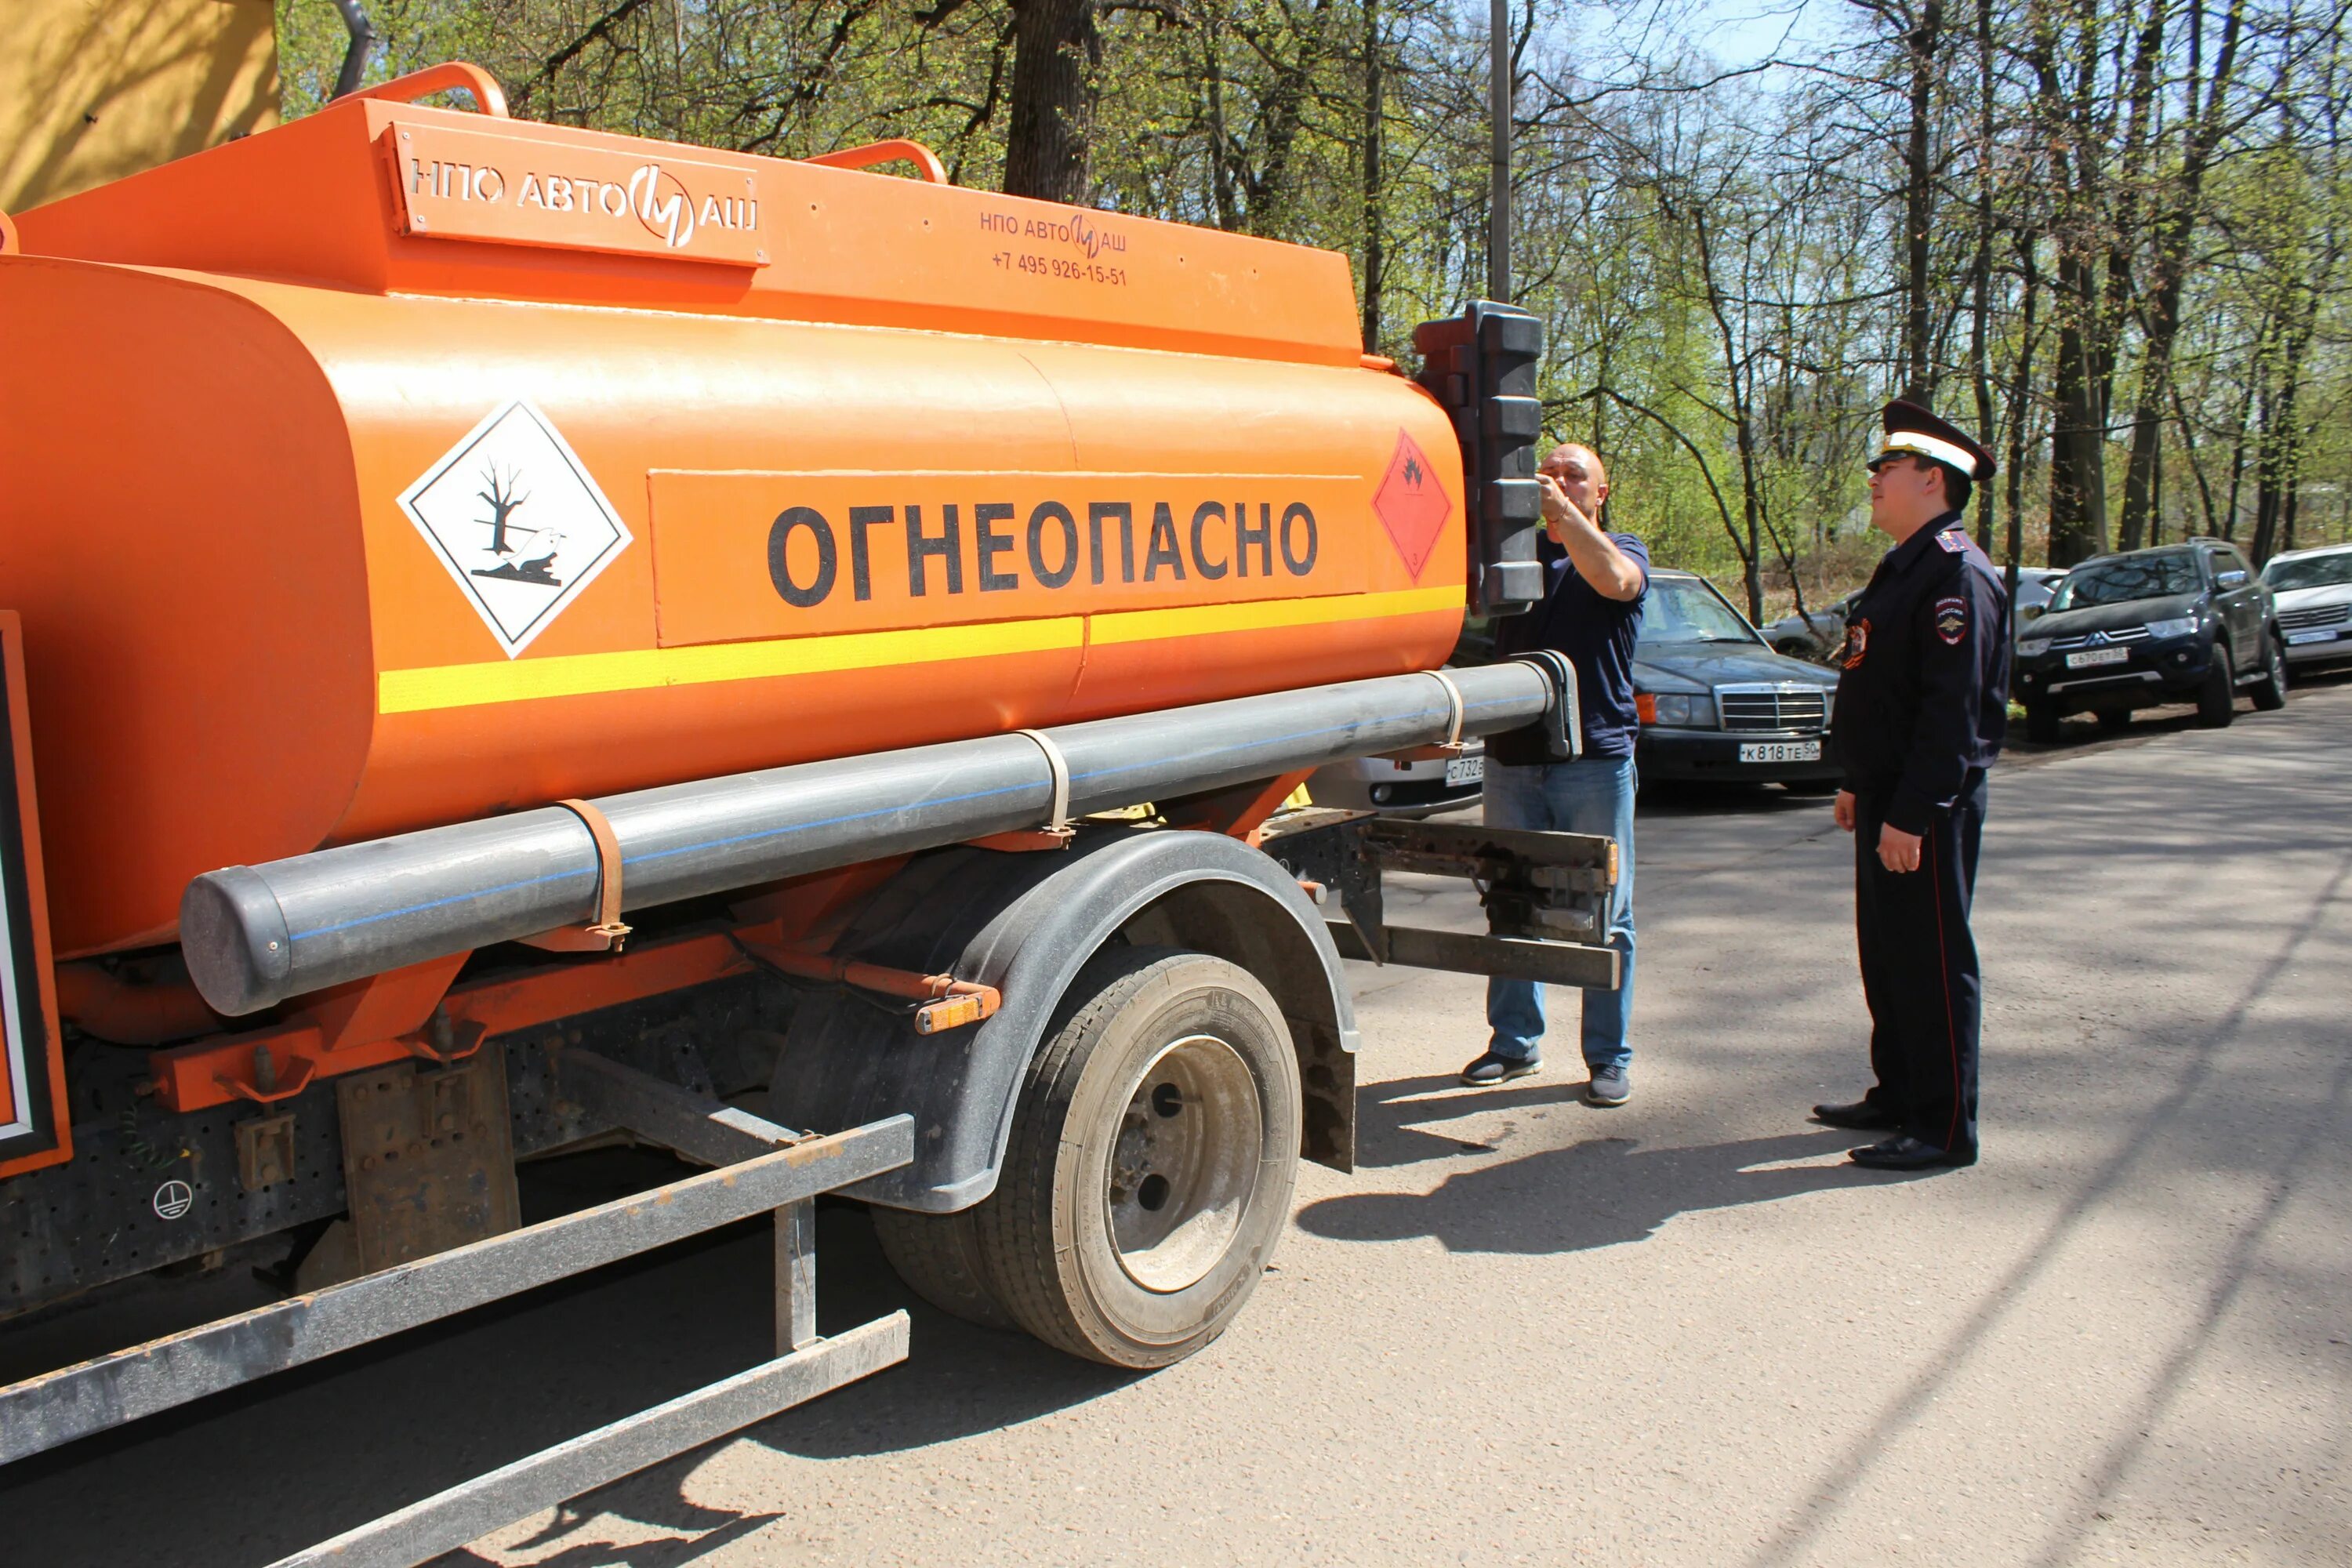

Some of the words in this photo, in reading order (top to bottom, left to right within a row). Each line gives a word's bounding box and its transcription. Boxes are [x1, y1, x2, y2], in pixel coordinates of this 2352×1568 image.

[411, 158, 505, 202] НПО
[980, 212, 1018, 234] НПО
[992, 252, 1011, 270] +7
[1018, 254, 1047, 274] 495
[1052, 259, 1127, 287] 926-15-51
[767, 500, 1318, 608] ОГНЕОПАСНО
